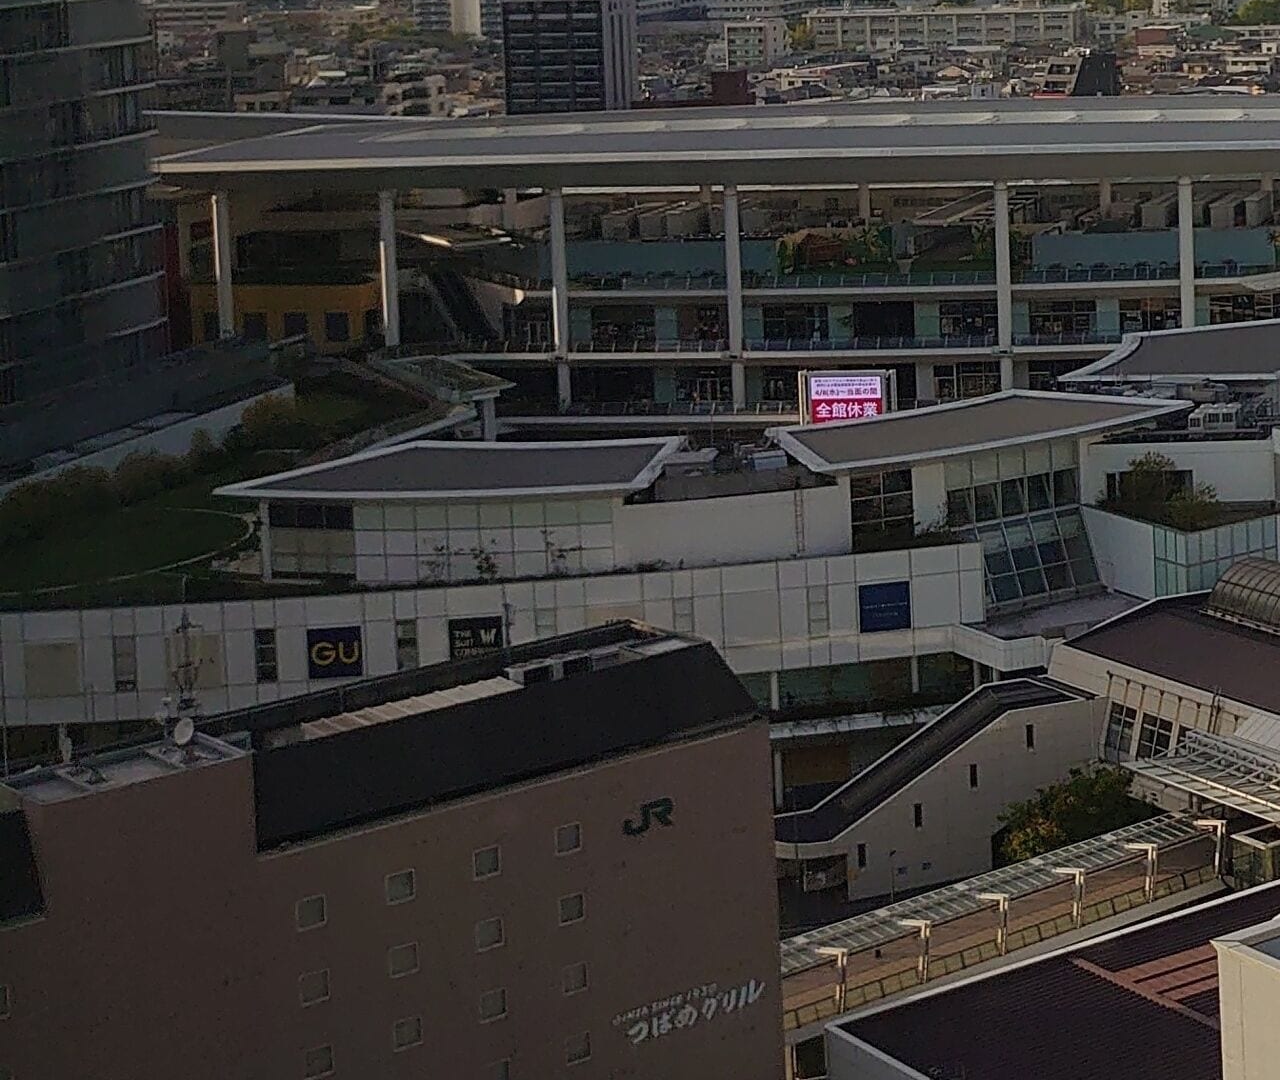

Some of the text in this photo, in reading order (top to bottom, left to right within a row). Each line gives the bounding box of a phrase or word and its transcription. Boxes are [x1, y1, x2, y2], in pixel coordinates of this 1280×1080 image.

[816, 402, 878, 418] 全館休業
[311, 640, 359, 666] GU
[622, 797, 674, 836] JR
[627, 979, 766, 1044] つばめグリル
